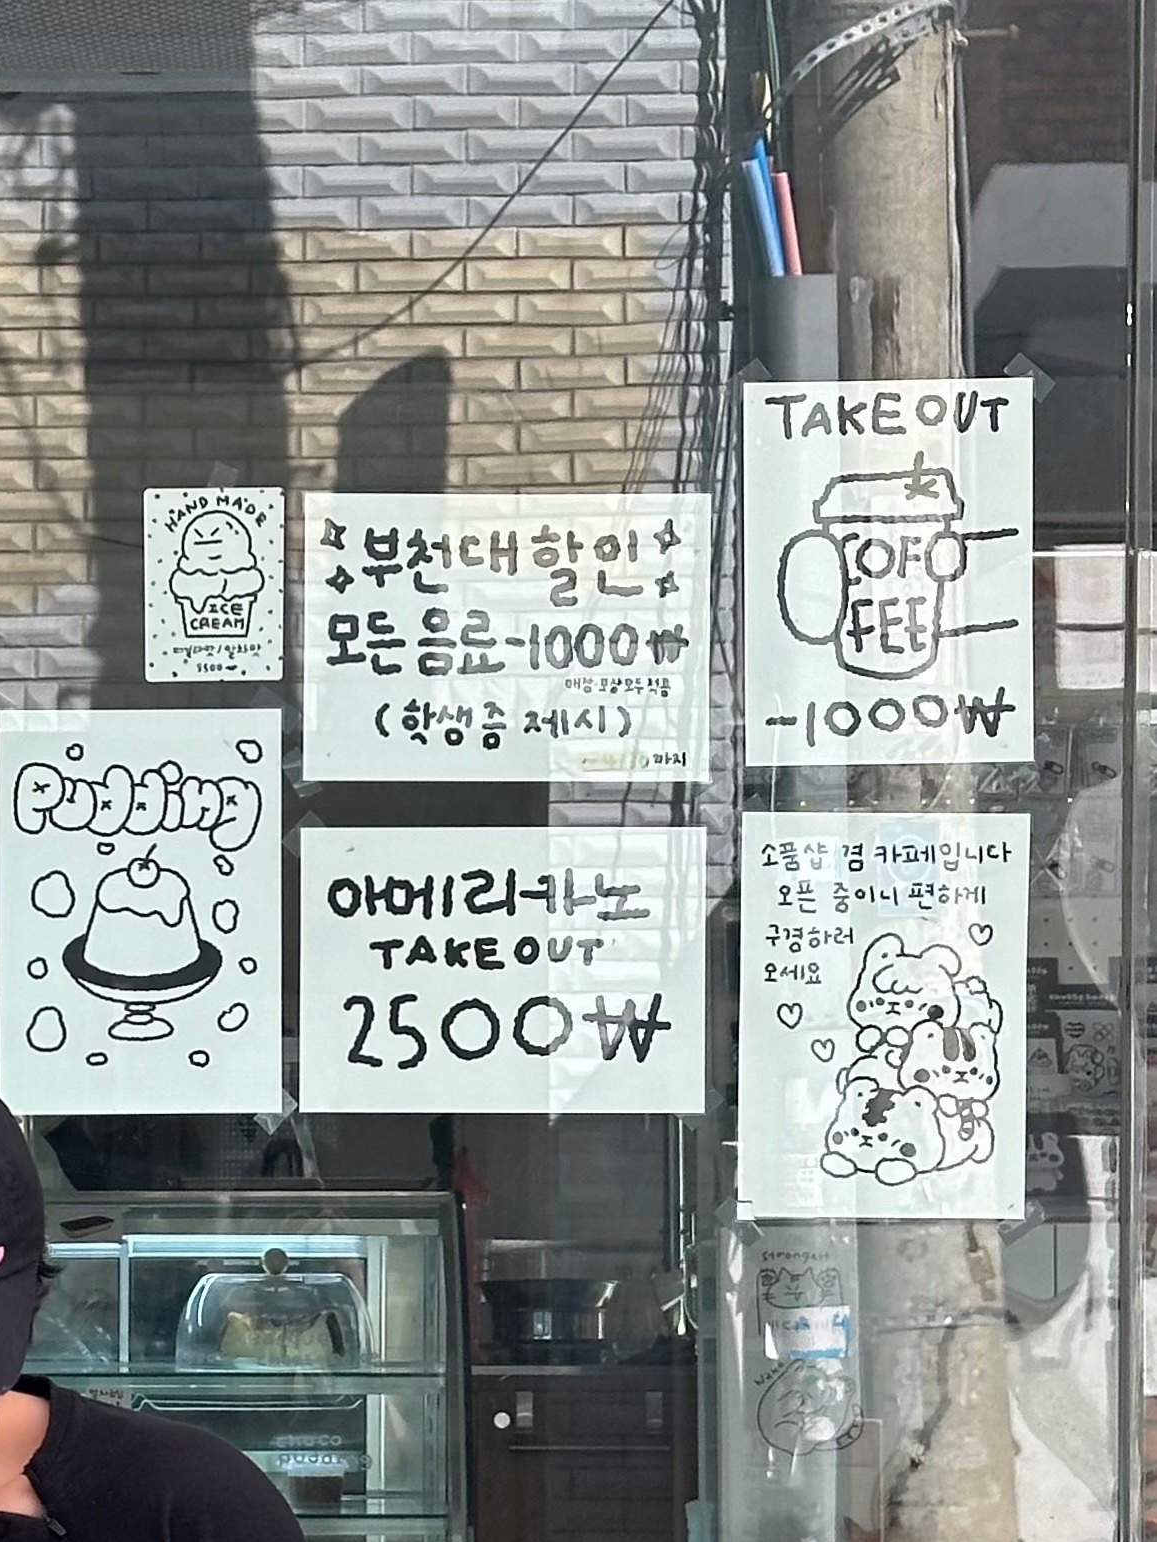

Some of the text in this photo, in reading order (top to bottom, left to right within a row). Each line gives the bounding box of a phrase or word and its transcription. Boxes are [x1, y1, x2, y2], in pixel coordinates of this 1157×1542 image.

[189, 617, 245, 631] CREAM
[207, 602, 244, 617] ICE
[326, 611, 406, 676] 모든
[761, 842, 1012, 872] 소품샵 겸 카페입니다
[328, 868, 650, 921] 아메리카노
[778, 881, 985, 913] 오픈 중이니 편하게
[765, 924, 853, 953] 구경하러
[764, 962, 821, 985] 오세요
